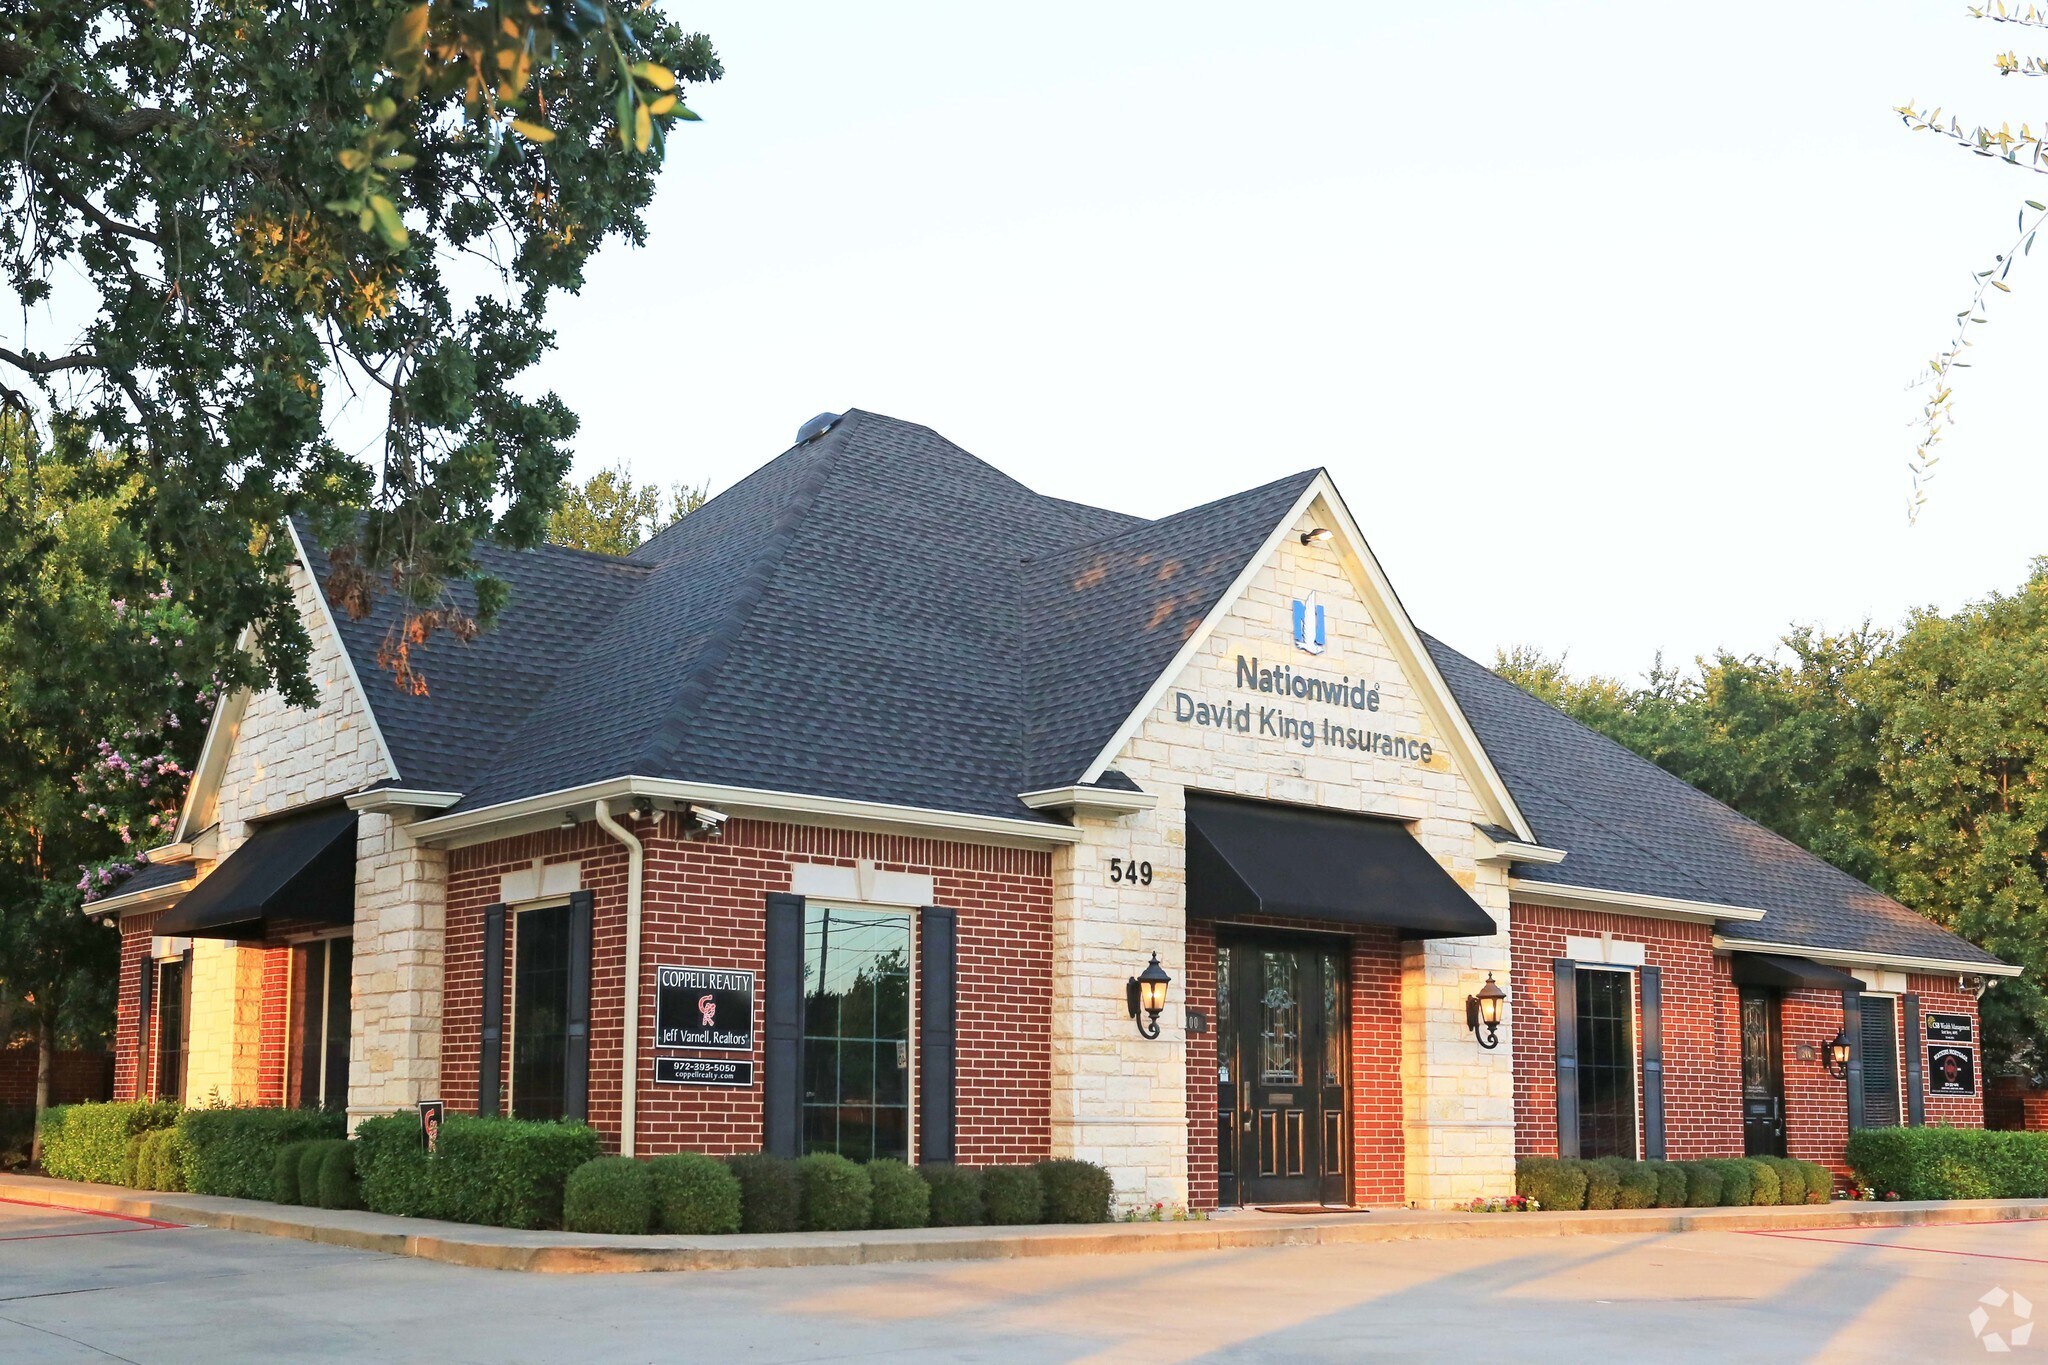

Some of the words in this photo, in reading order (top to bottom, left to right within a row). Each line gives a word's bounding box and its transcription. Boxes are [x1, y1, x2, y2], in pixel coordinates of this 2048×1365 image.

[1175, 691, 1250, 733] David
[1260, 706, 1315, 748] King
[1323, 718, 1432, 764] Insurance
[1110, 857, 1153, 886] 549
[662, 970, 707, 989] COPPELL
[709, 973, 750, 991] REALTY
[663, 1029, 678, 1043] Jeff
[680, 1030, 712, 1044] Varnell,
[673, 1062, 736, 1072] 972-393-5050
[675, 1071, 734, 1081] coppellrealty.com
